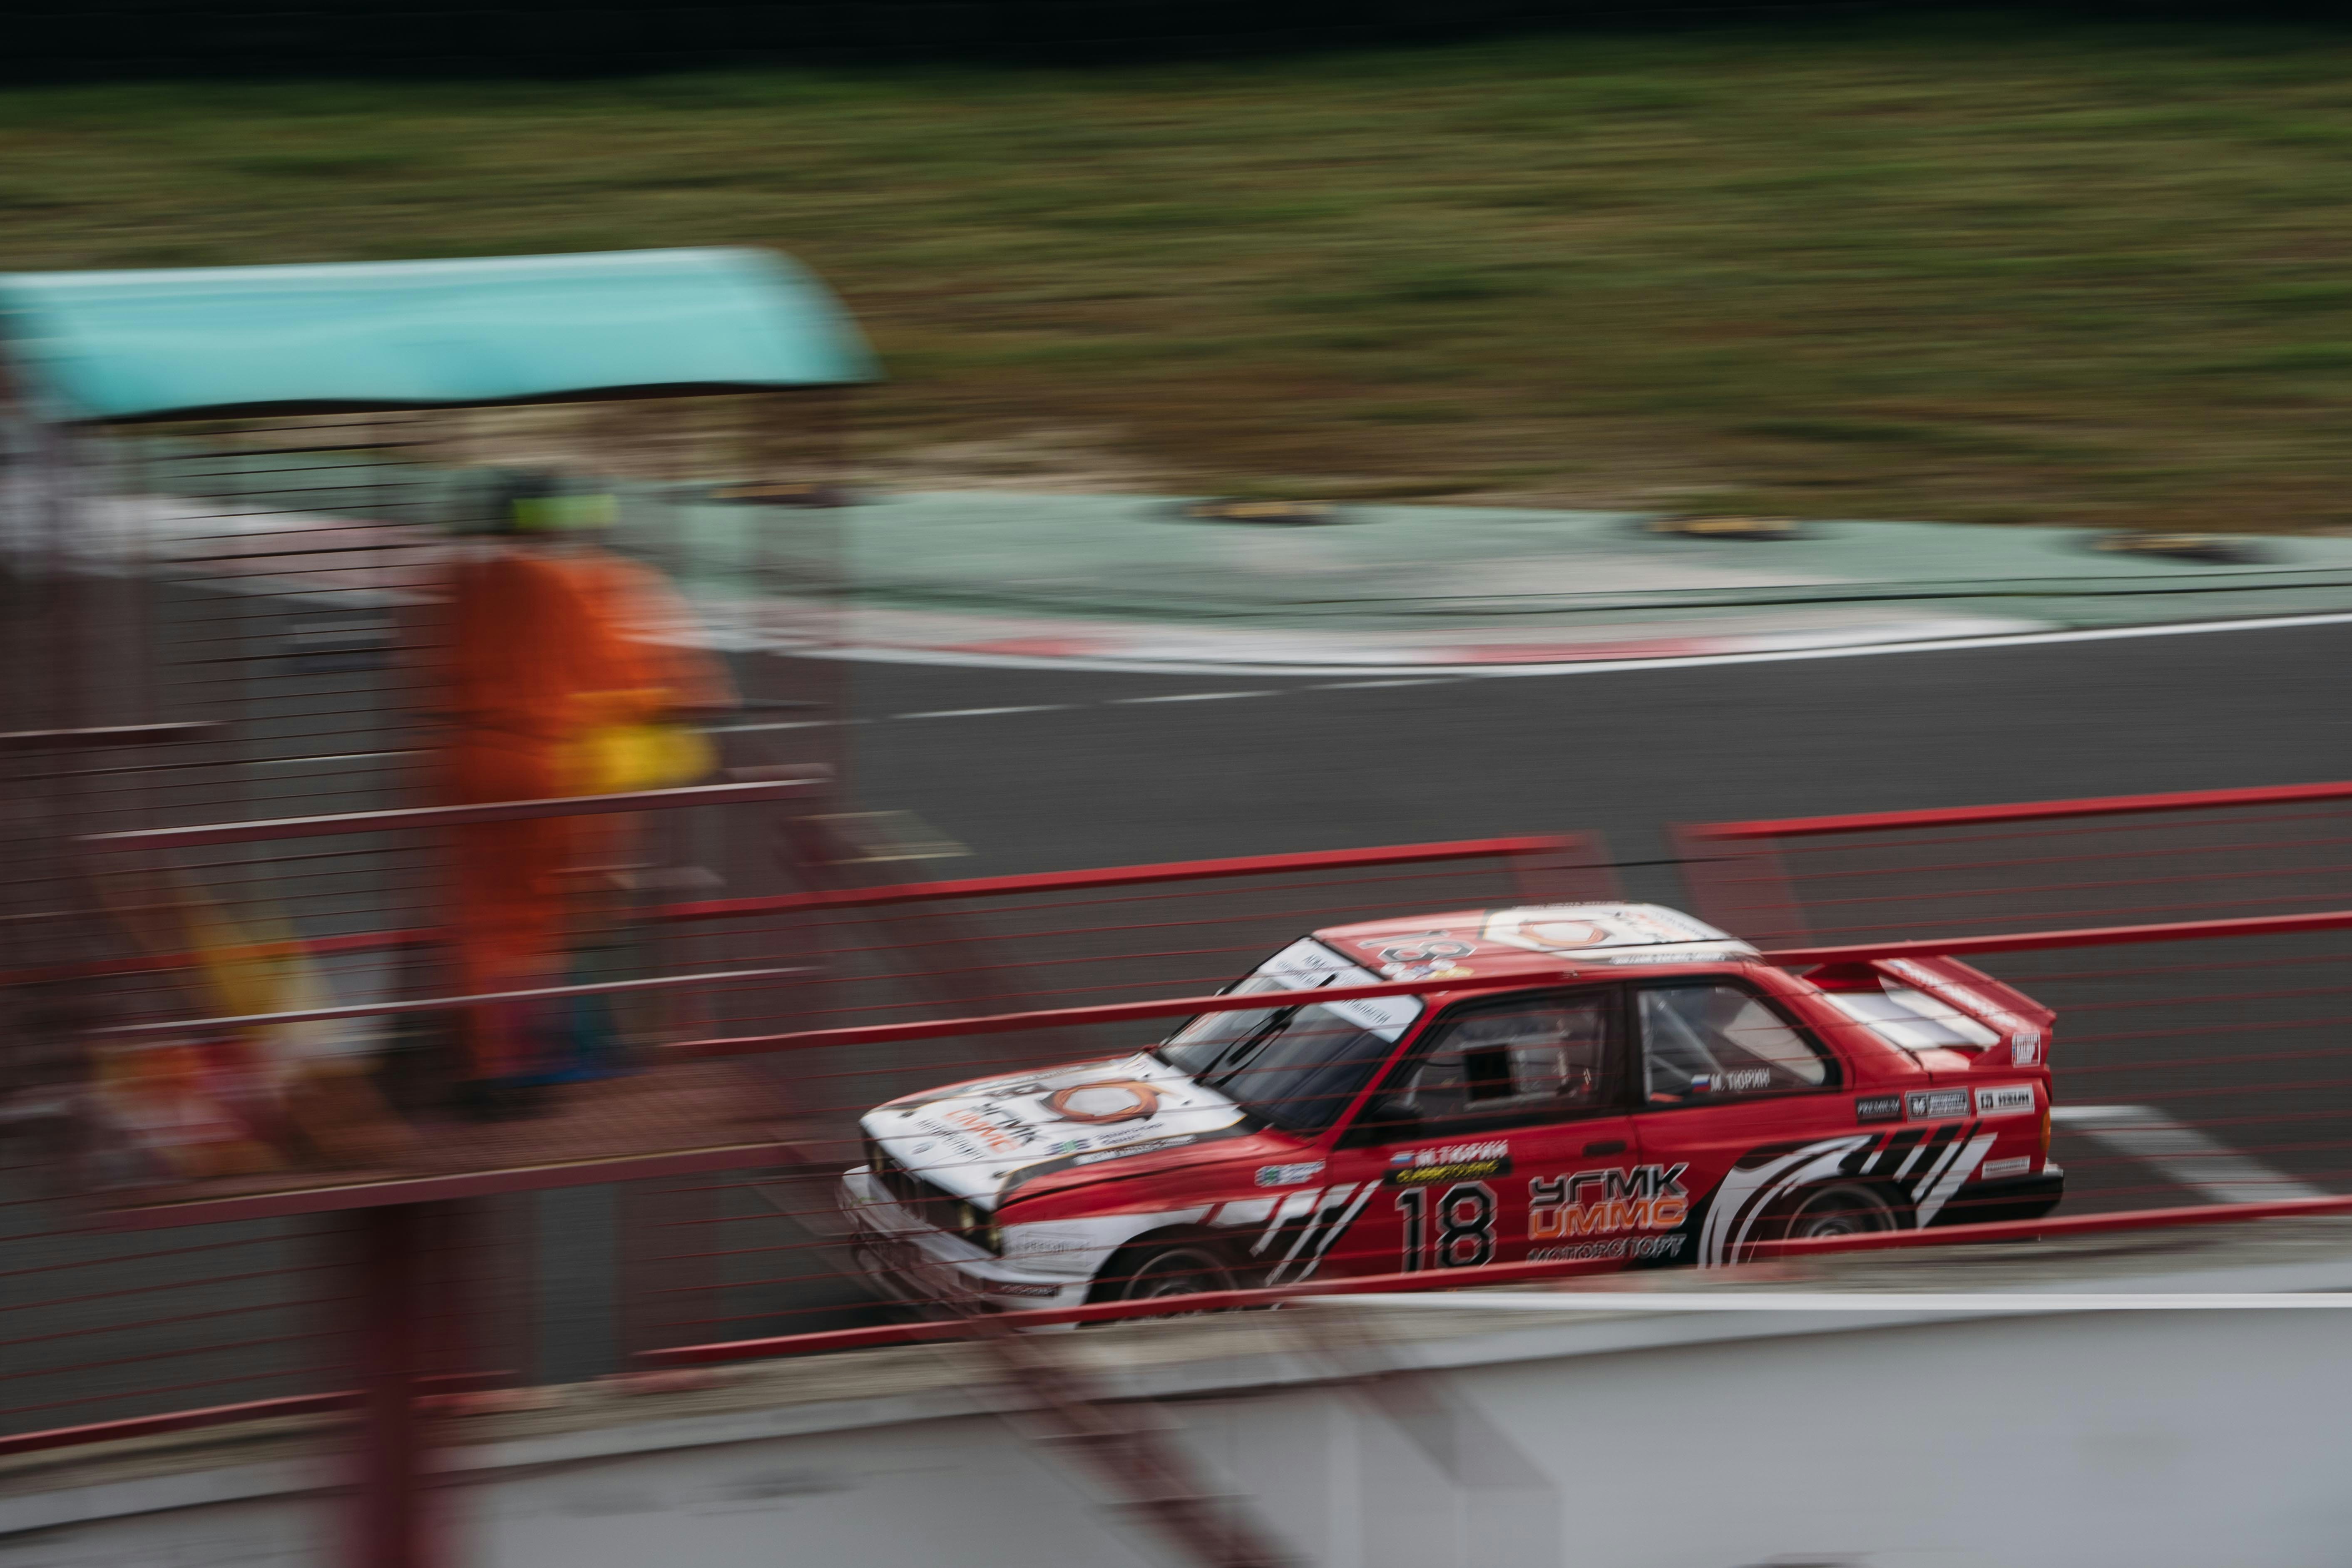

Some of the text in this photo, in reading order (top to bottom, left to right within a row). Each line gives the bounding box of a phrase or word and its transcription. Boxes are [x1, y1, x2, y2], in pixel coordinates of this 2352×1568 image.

[1726, 1067, 1770, 1091] ТЮРИН
[1529, 1162, 1690, 1210] УГМК
[1395, 1180, 1498, 1276] 18
[1527, 1197, 1689, 1241] UMMC
